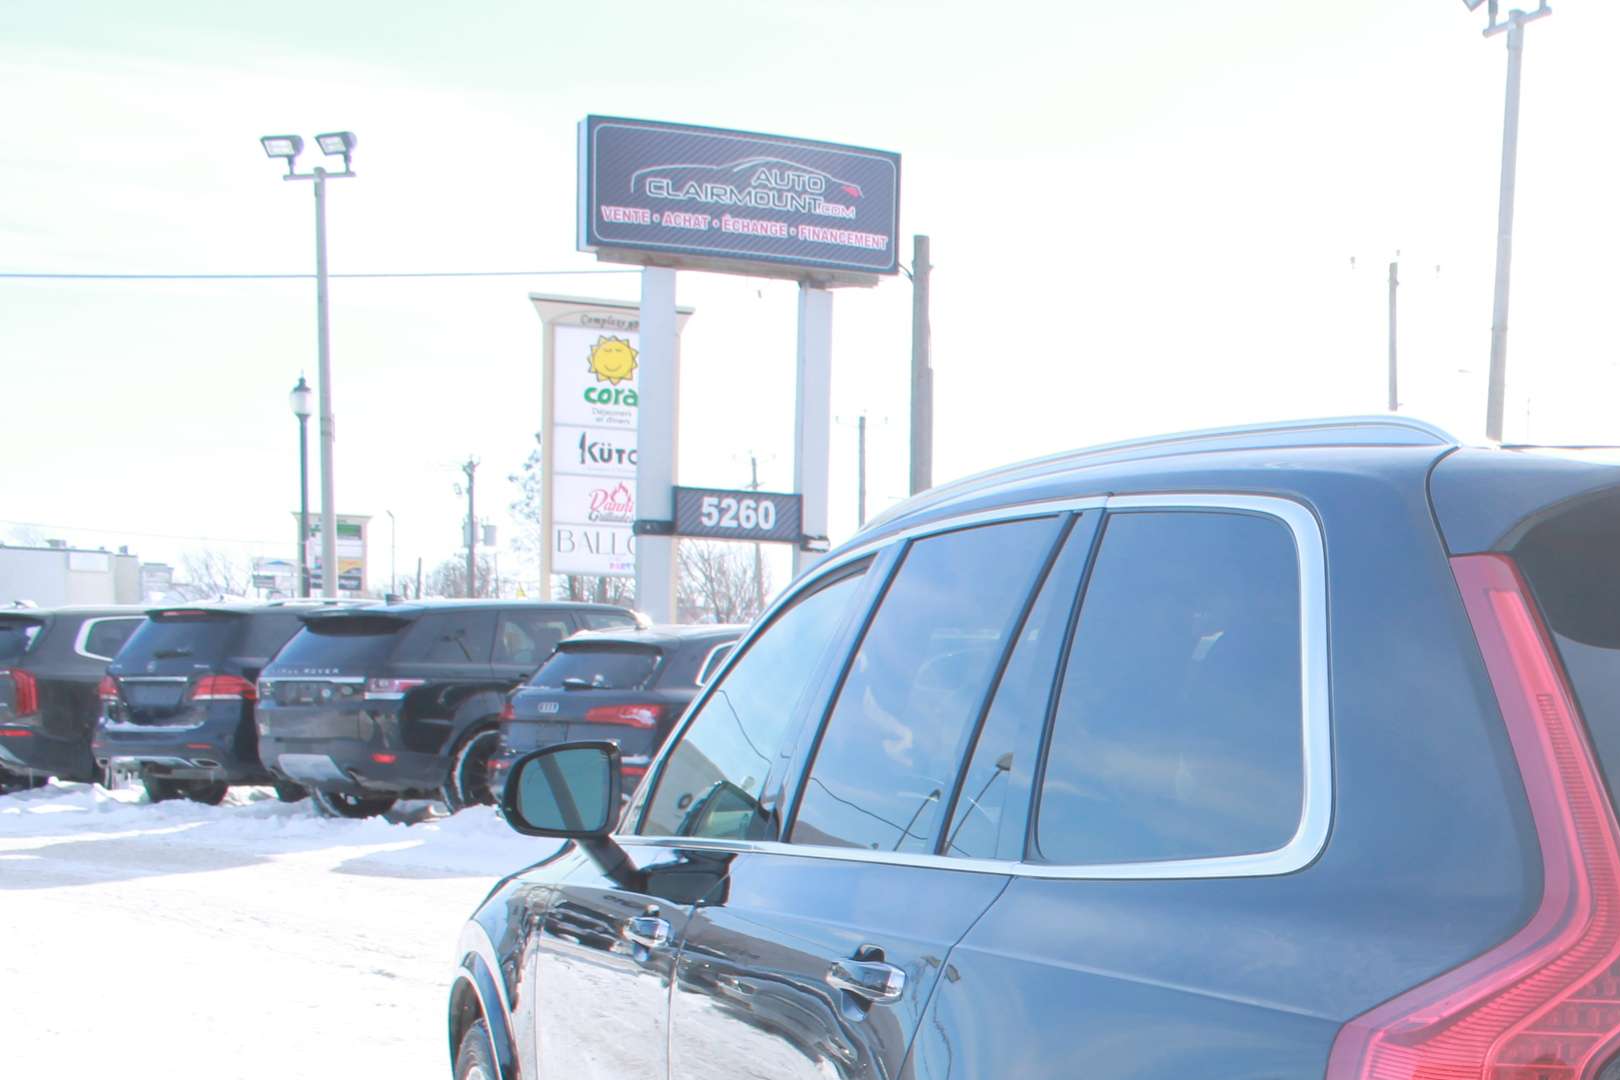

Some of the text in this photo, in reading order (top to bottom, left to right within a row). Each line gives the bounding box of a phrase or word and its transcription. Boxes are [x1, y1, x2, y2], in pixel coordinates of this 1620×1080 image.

[751, 167, 826, 193] AUTO
[601, 205, 889, 250] VENTE ACHAT ÉCHANGE FINANCEMENT
[583, 386, 639, 408] cora
[701, 496, 776, 530] 5260
[557, 529, 637, 556] BALL
